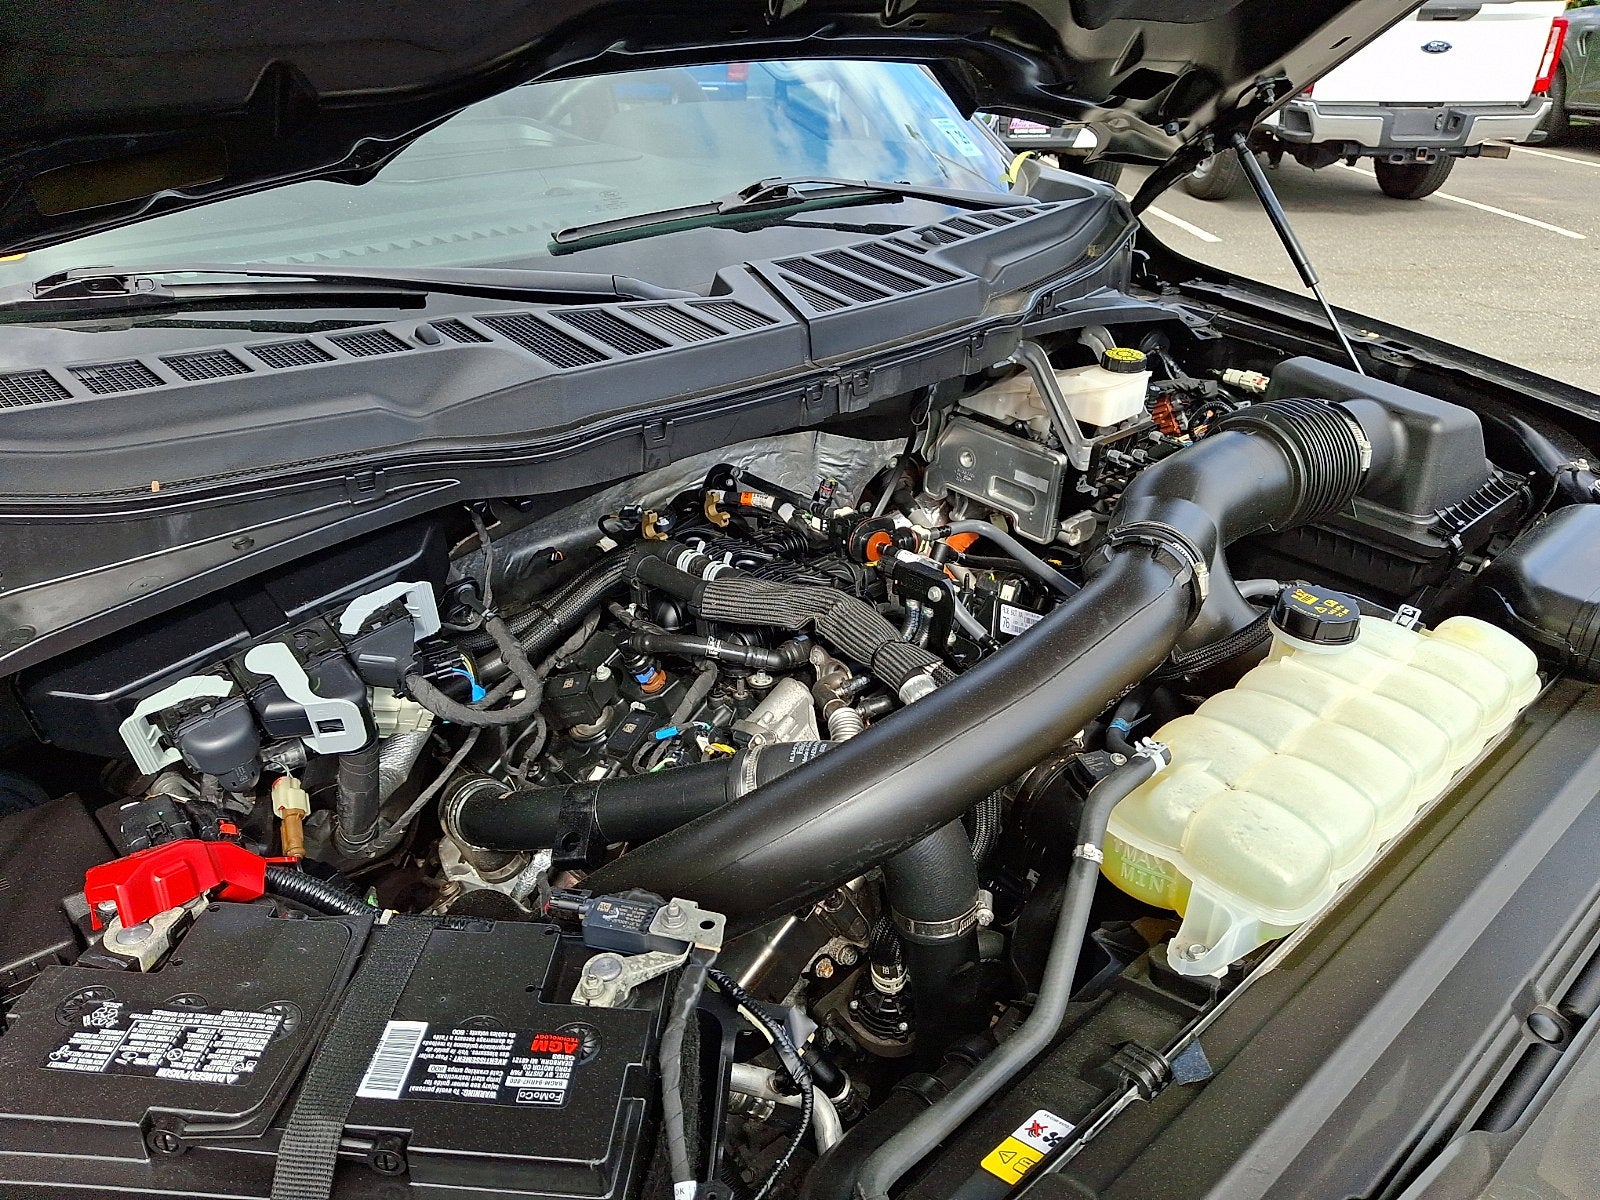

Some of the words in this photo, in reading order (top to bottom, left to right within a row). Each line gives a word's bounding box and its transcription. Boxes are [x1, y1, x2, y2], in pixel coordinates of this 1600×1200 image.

[1124, 845, 1166, 874] MAX
[1120, 862, 1164, 894] MIN
[534, 1034, 578, 1042] TECHNOLOGY
[531, 1040, 578, 1053] AGM
[461, 1089, 497, 1099] WARNING:
[519, 1091, 562, 1102] FoMoCo
